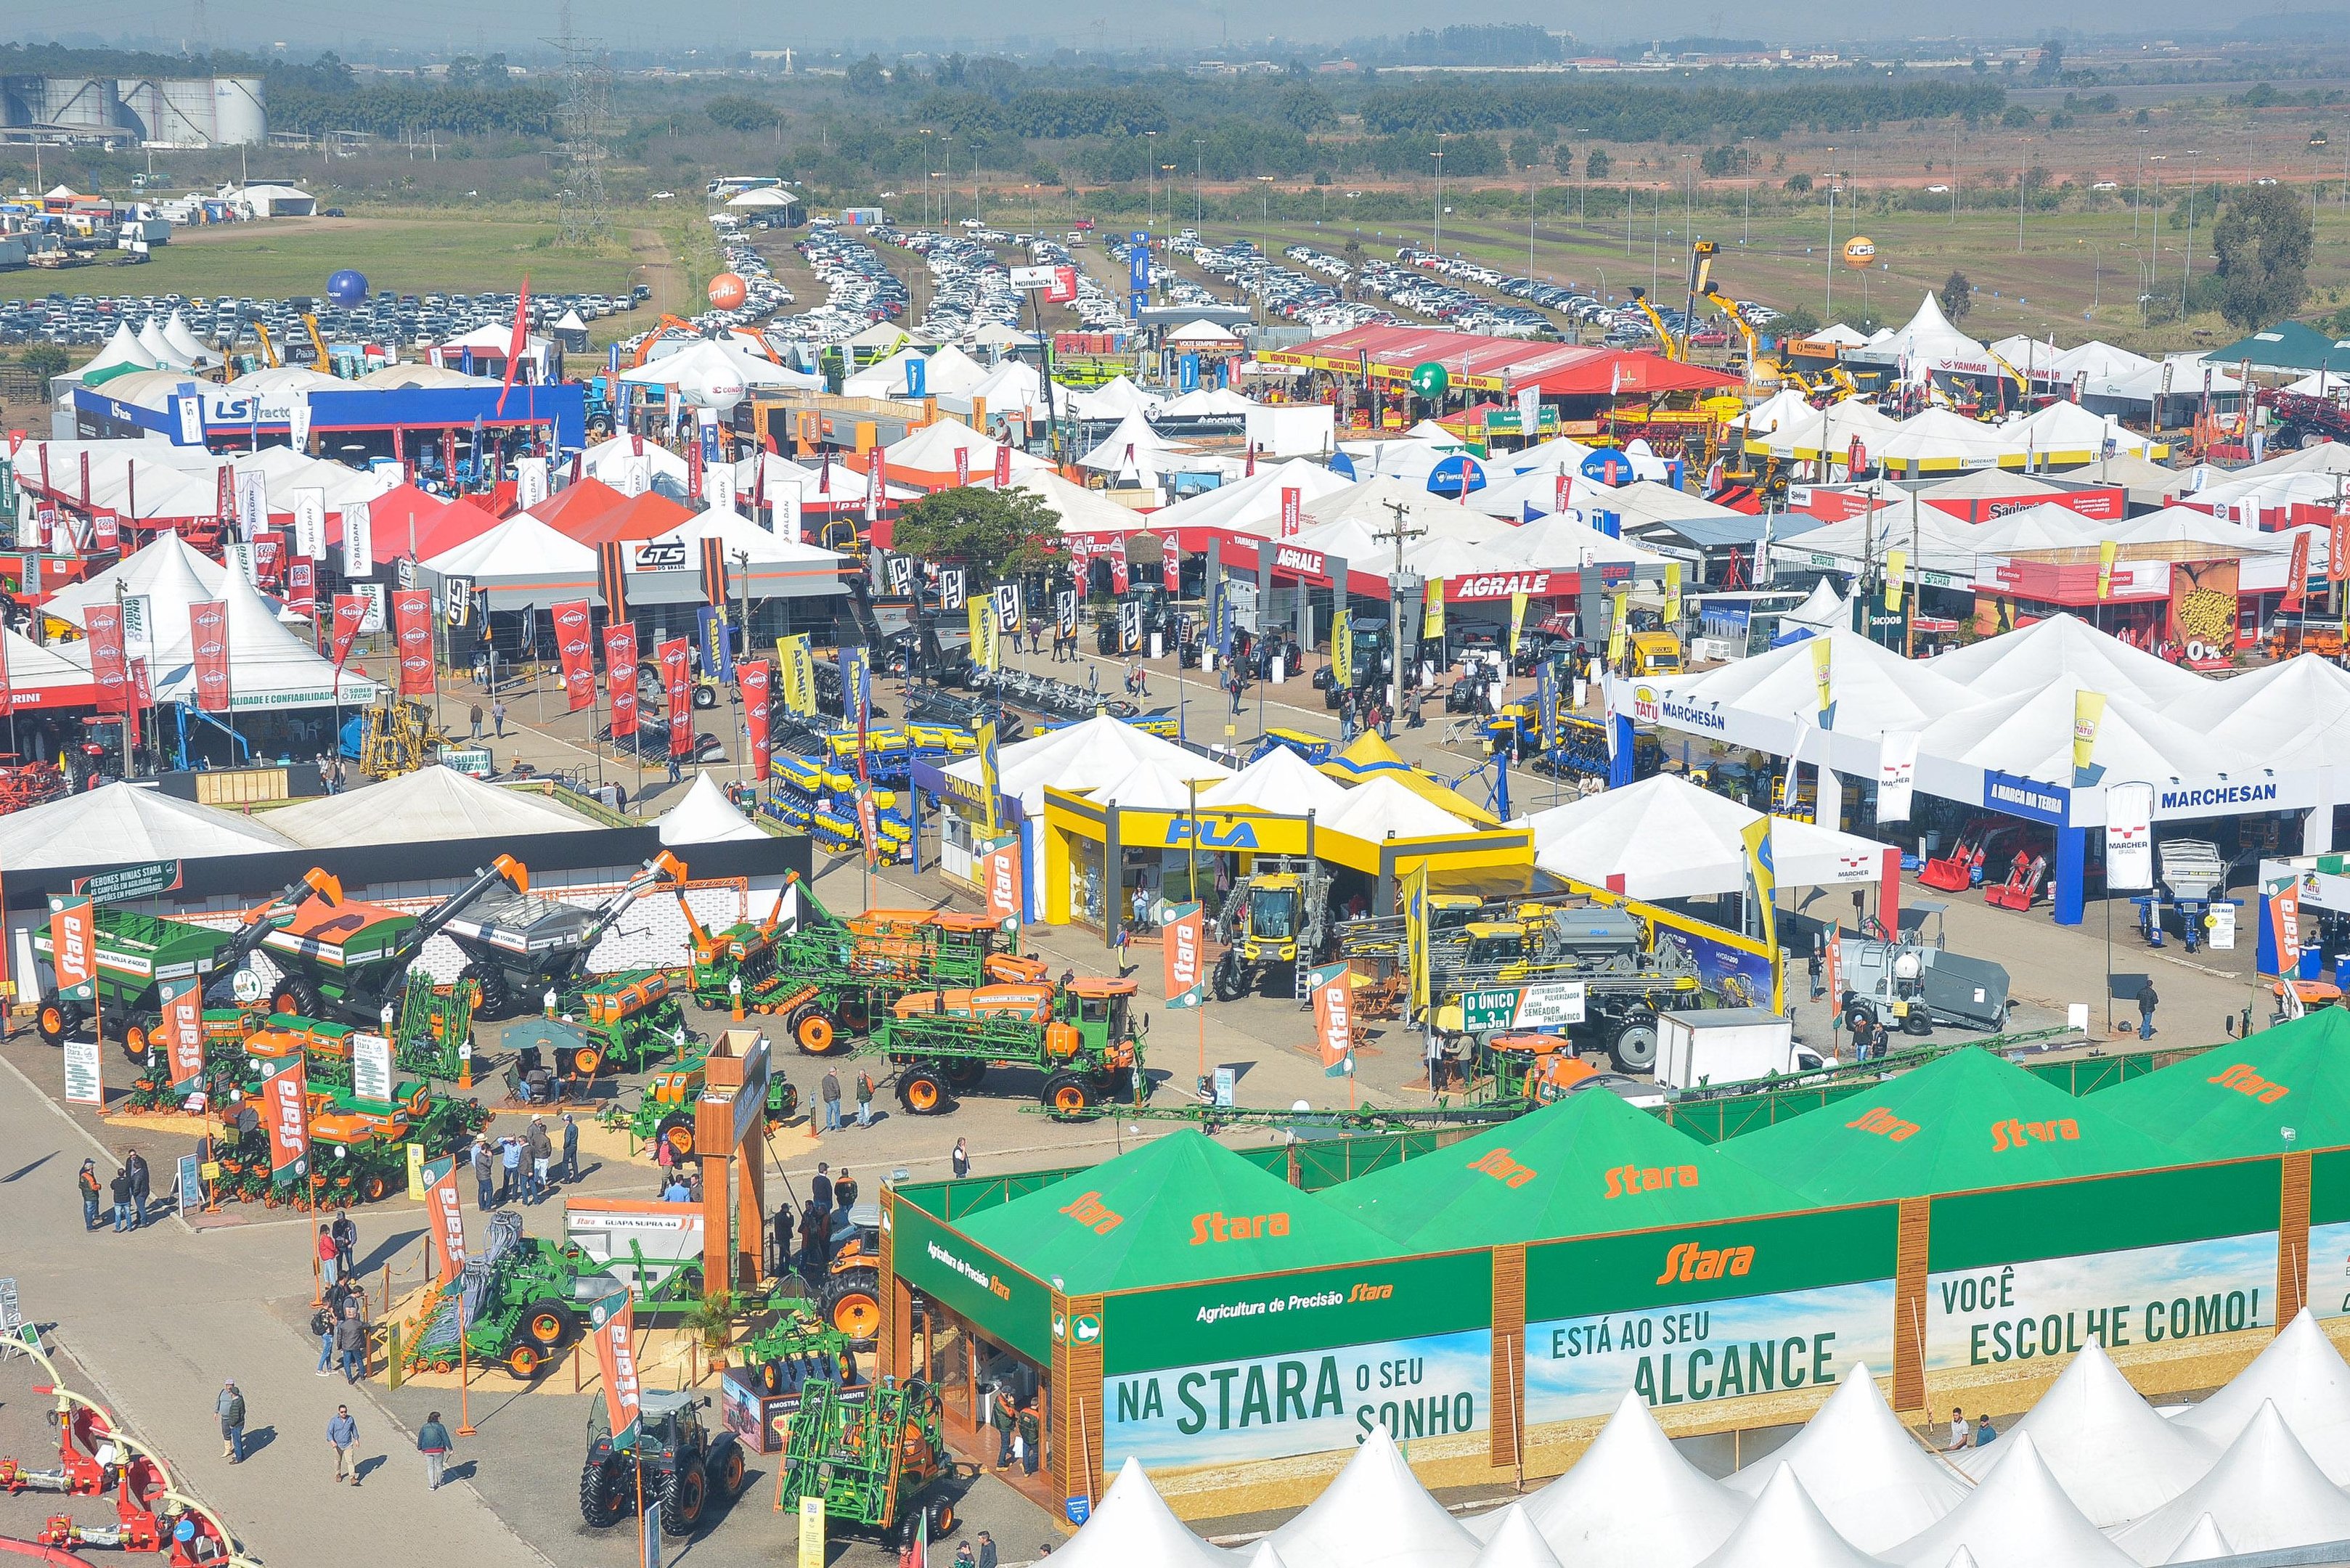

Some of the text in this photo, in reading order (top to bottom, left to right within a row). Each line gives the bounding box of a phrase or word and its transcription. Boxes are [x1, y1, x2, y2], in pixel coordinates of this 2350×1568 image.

[1328, 359, 1360, 371] VENCE TUDO
[1953, 362, 1987, 373] YANMAR
[216, 401, 248, 419] LS
[636, 547, 685, 562] GTS
[1276, 549, 1322, 574] AGRALE
[1457, 574, 1550, 597] AGRALE
[1872, 615, 1901, 625] SICOOB
[1635, 701, 1725, 730] TATU MARCHESAN
[1991, 783, 2062, 814] A MARCA DA TERRA
[2161, 783, 2277, 809] MARCHESAN
[1164, 818, 1260, 848] PLA
[2108, 841, 2147, 850] MARCHER
[91, 873, 118, 887] REBOKES
[120, 869, 141, 883] NINJAS
[142, 865, 162, 878] STARA
[993, 854, 1015, 913] Stara
[62, 915, 86, 979] Stara
[2280, 899, 2300, 957] Stara
[1173, 925, 1194, 983] Stara
[1326, 988, 1348, 1050] Stara
[1467, 991, 1514, 1010] O ÚNICO
[1524, 1006, 1560, 1016] SEMEADOR
[176, 1005, 201, 1069] Stara
[2207, 1063, 2290, 1104] Stara
[278, 1079, 303, 1152] Stara
[1845, 1106, 1921, 1142] Stara
[1991, 1118, 2079, 1152] Stara
[1466, 1148, 1538, 1188] Stara
[1604, 1164, 1699, 1199] Stara
[438, 1188, 466, 1262] Stara
[1058, 1191, 1125, 1236] Stara
[1189, 1211, 1290, 1246] Stara
[928, 1240, 1011, 1301] Agricultura de Precisão Stara
[1655, 1241, 1755, 1286] Stara
[1196, 1283, 1394, 1323] Agricultura de Precisão Stara
[1941, 1265, 2015, 1315] VOCÊ
[1552, 1310, 1710, 1359] ESTÁ AO SEU
[1970, 1289, 2259, 1365] ESCOLHE COMO!
[611, 1325, 640, 1408] Stara
[1634, 1332, 1837, 1407] ALCANCE
[770, 1400, 799, 1410] AMOSTRA
[1117, 1355, 1424, 1436] NA STARA O SEU
[1356, 1391, 1475, 1447] SONHO
